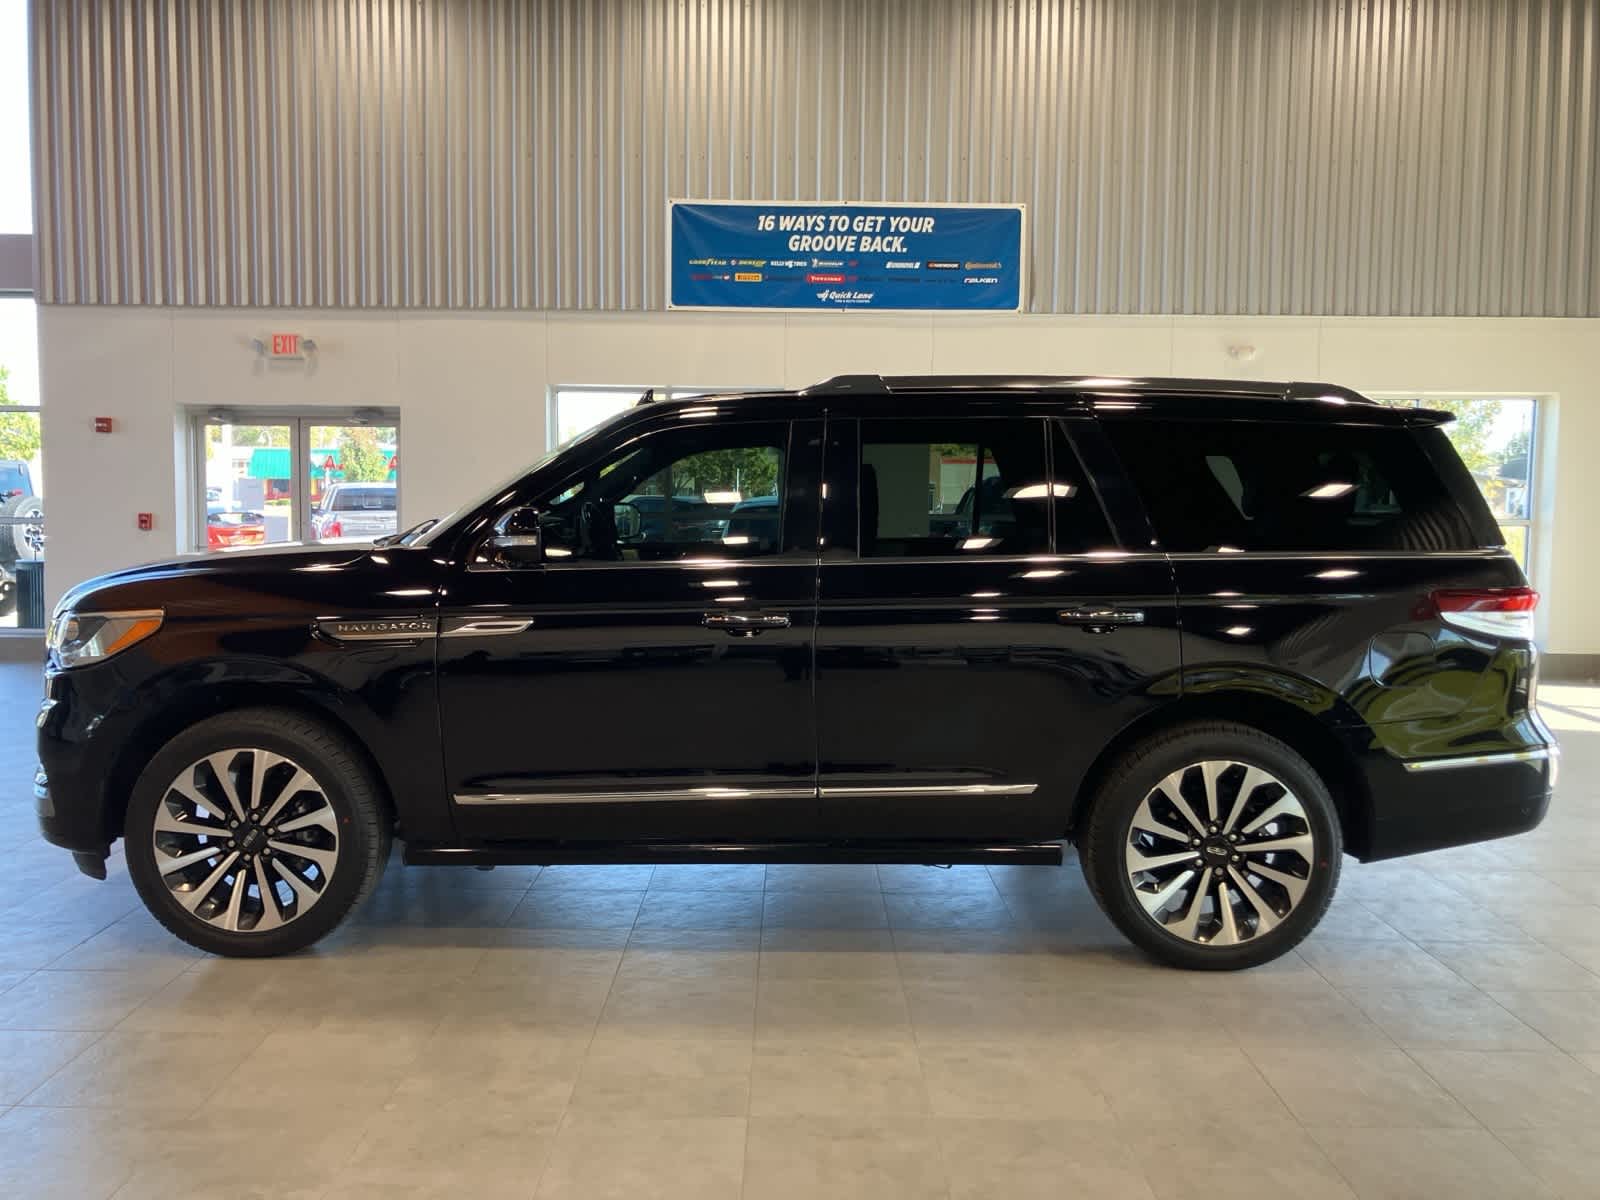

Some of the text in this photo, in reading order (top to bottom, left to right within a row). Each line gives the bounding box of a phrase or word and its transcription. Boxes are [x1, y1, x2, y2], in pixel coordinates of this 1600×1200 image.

[757, 215, 935, 233] 16 WAYS TO GET YOUR
[788, 235, 908, 253] GROOVE BACK.
[829, 291, 874, 299] Quick Lane
[272, 334, 298, 354] EXIT
[338, 622, 432, 632] NAVIGATOR
